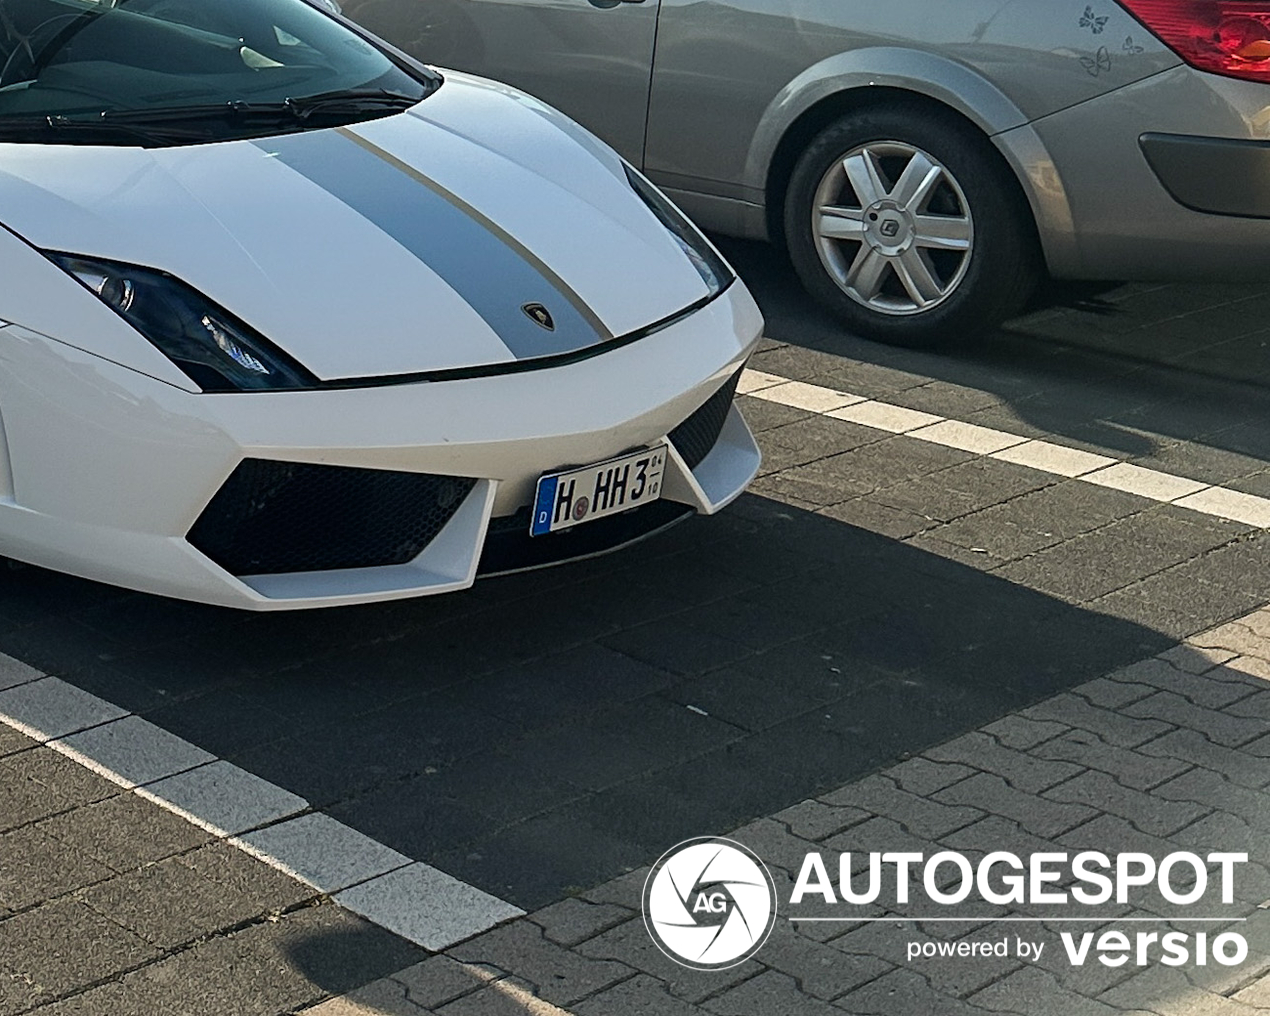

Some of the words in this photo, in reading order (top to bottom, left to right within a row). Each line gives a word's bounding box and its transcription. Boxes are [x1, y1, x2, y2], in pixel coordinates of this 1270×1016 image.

[538, 511, 548, 524] D
[553, 479, 576, 524] H
[591, 464, 630, 513] HH
[631, 458, 650, 501] 3
